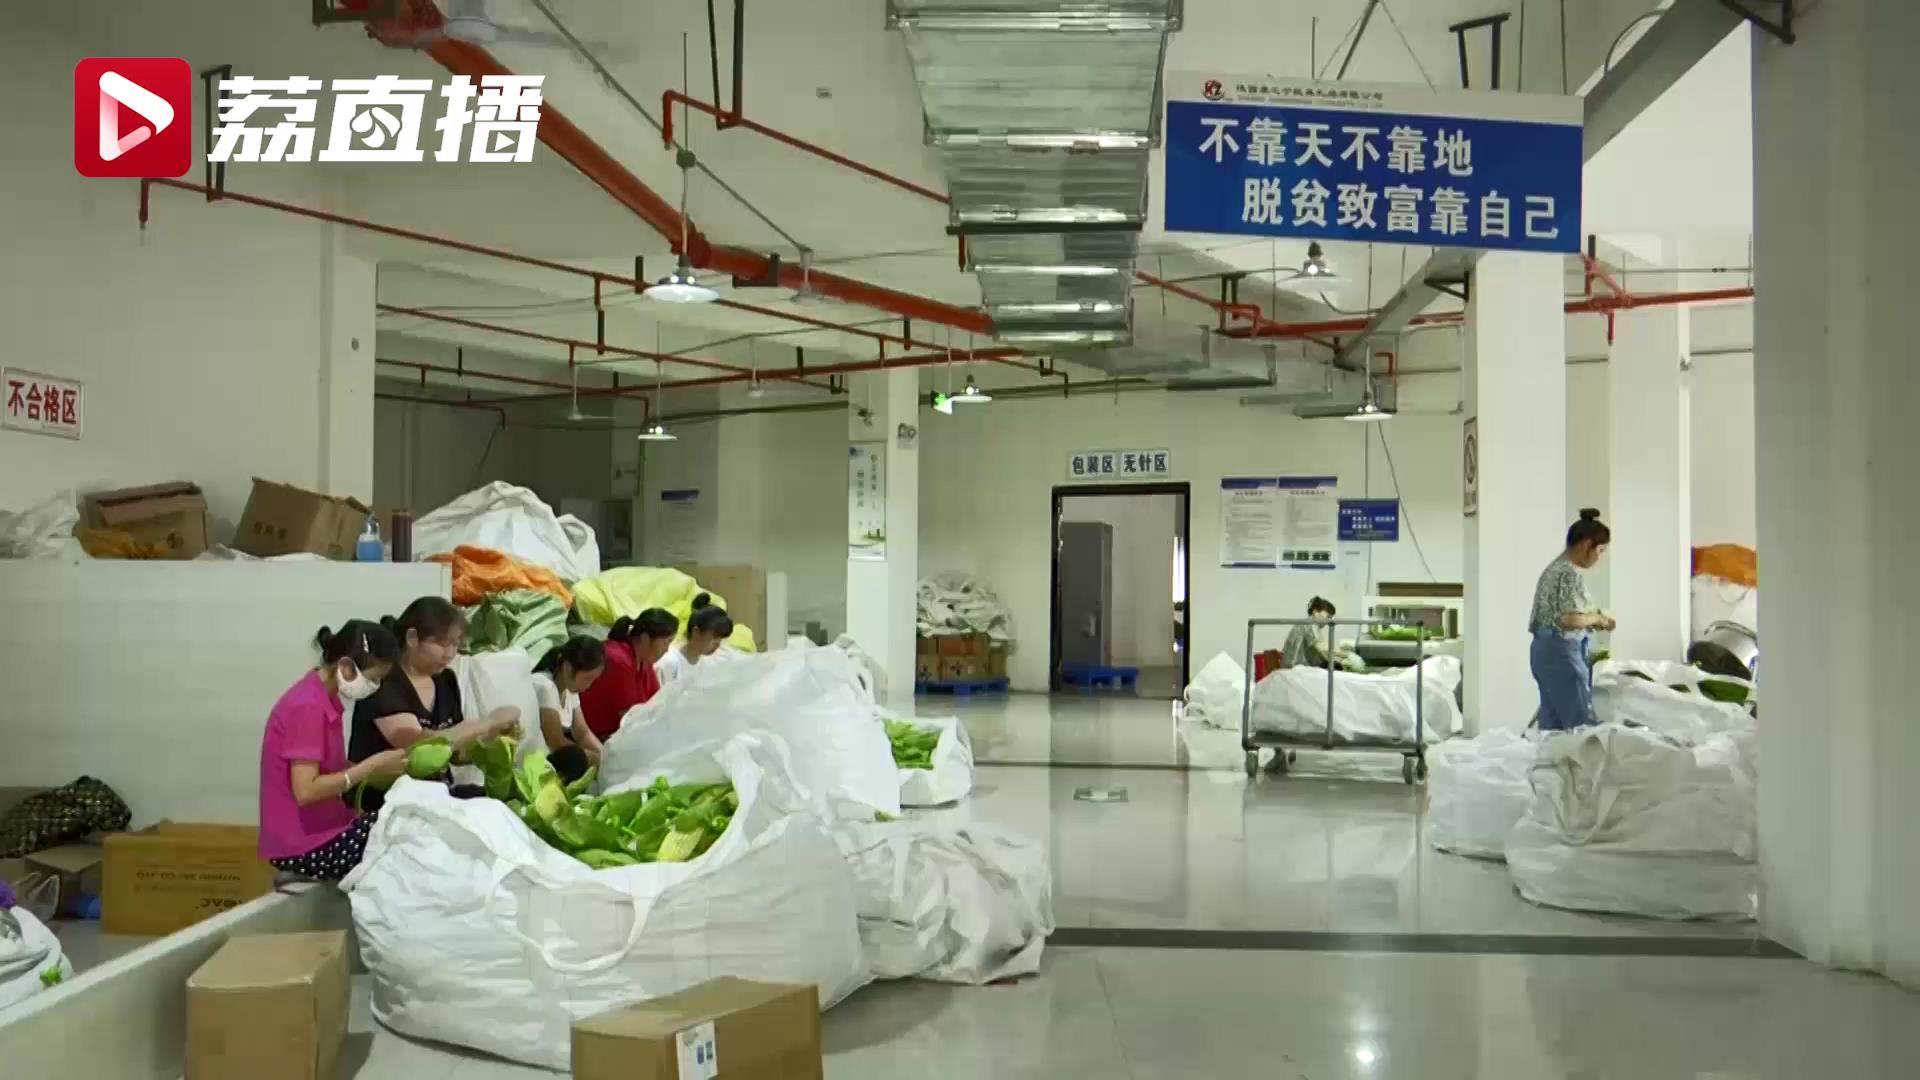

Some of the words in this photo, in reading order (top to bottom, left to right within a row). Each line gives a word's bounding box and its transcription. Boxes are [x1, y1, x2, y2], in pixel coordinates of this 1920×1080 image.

[1199, 117, 1473, 177] 不靠天不靠地
[1241, 177, 1559, 239] 脱贫致富靠自己
[8, 380, 77, 425] 不合格区
[1072, 456, 1113, 475] 包装区
[1124, 454, 1167, 473] 无针区
